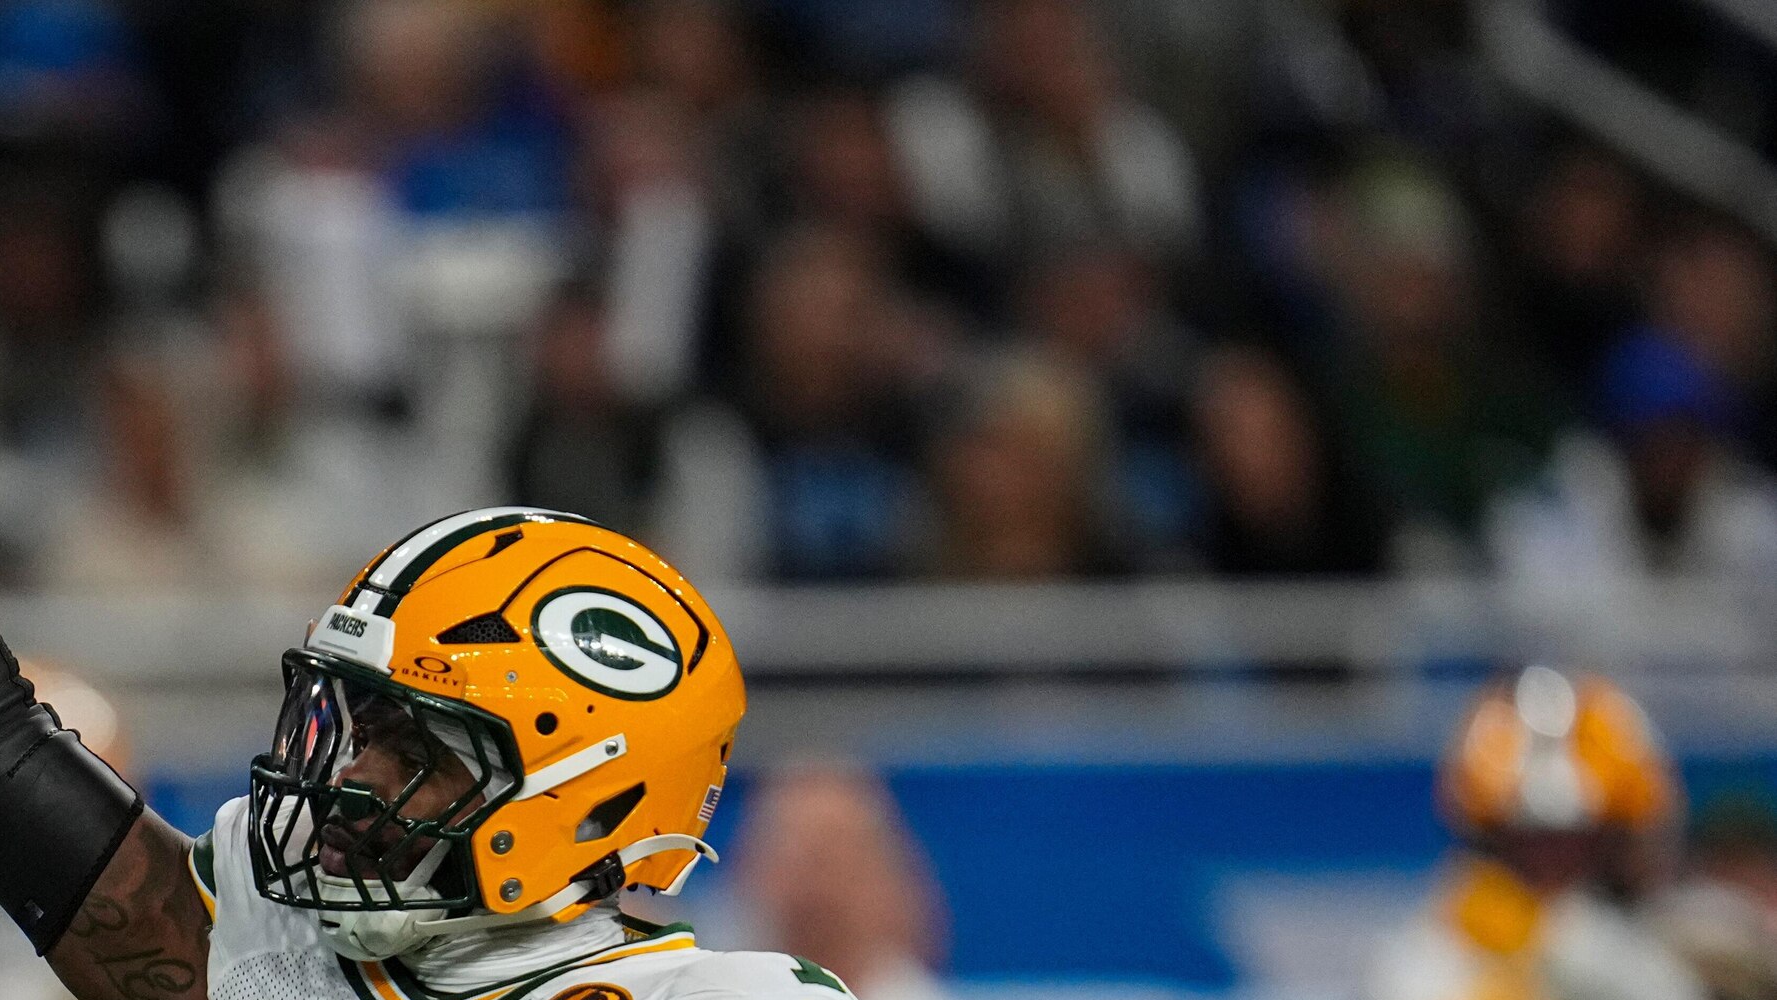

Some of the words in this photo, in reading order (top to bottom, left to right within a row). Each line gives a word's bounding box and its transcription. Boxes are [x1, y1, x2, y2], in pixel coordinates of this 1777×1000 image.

[326, 612, 368, 638] PACKERS
[531, 585, 683, 701] G
[401, 668, 459, 687] OAKLEY
